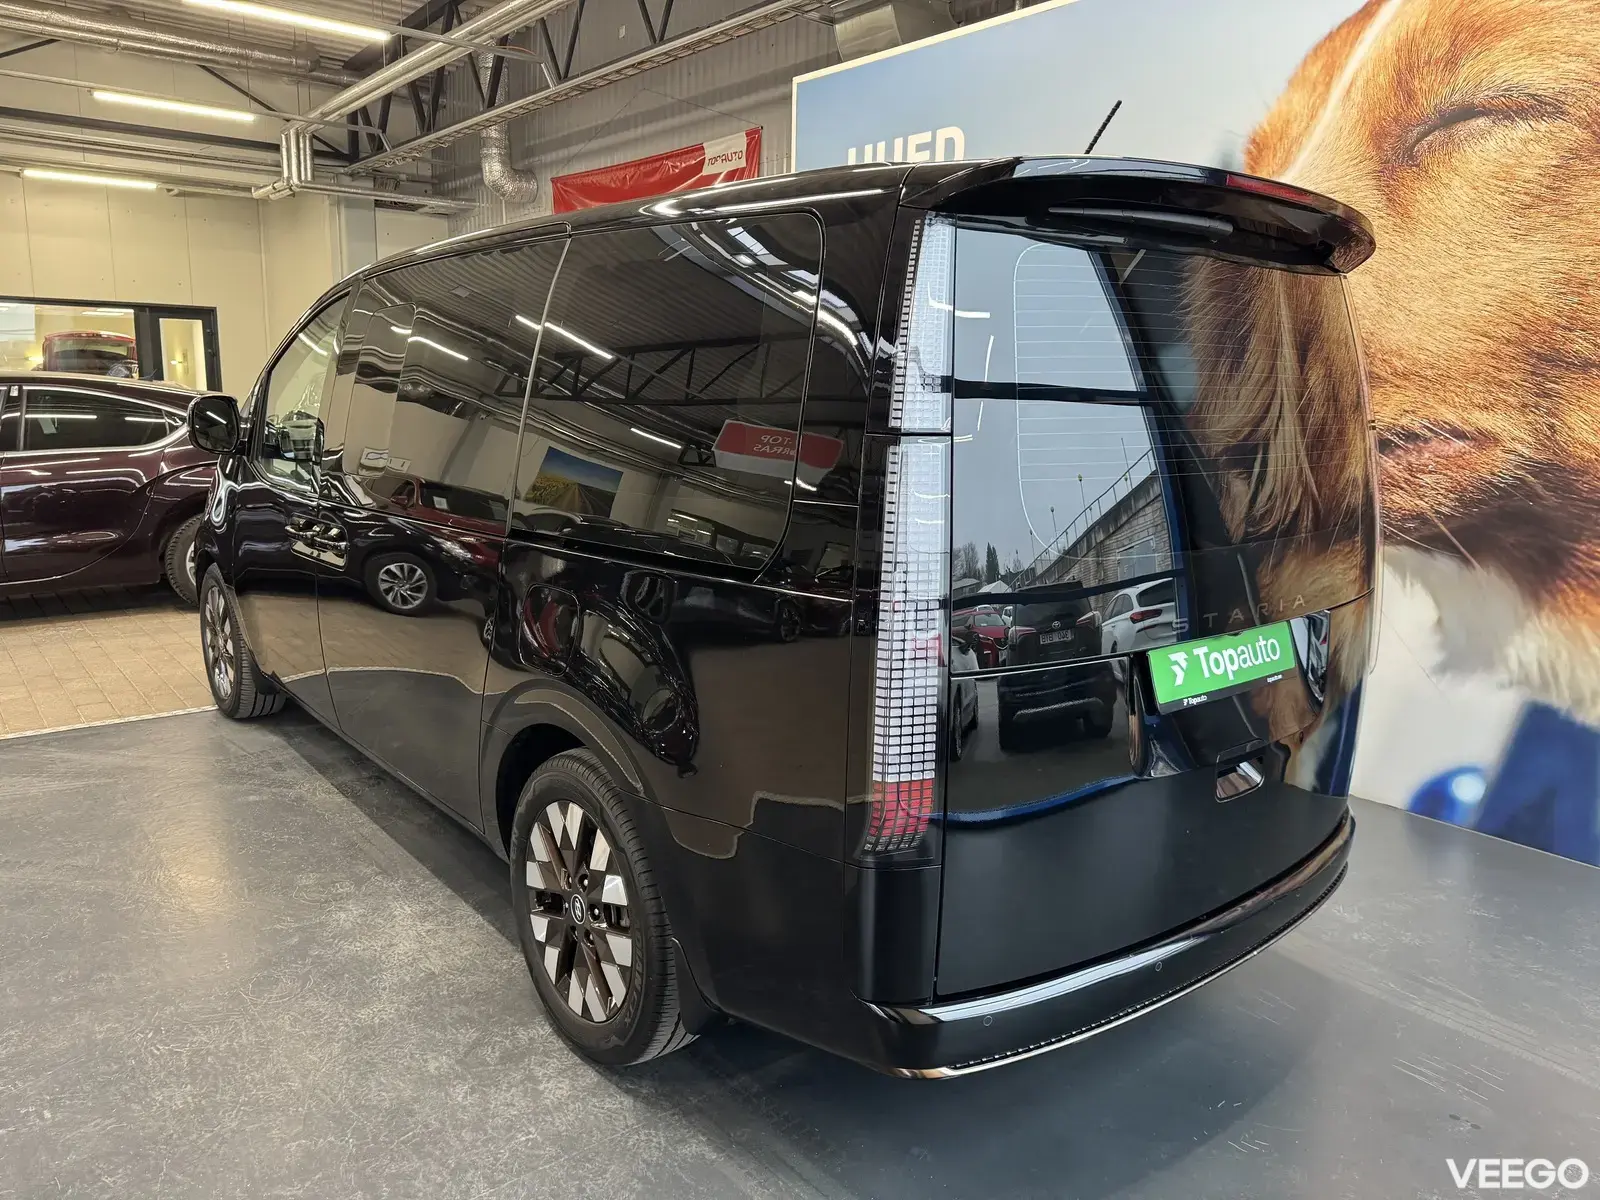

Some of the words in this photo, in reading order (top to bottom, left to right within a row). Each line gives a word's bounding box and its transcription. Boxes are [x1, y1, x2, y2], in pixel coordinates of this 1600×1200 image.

[707, 150, 744, 166] TOPAUTO
[1171, 594, 1306, 633] STARIA
[1193, 635, 1280, 681] Topauto
